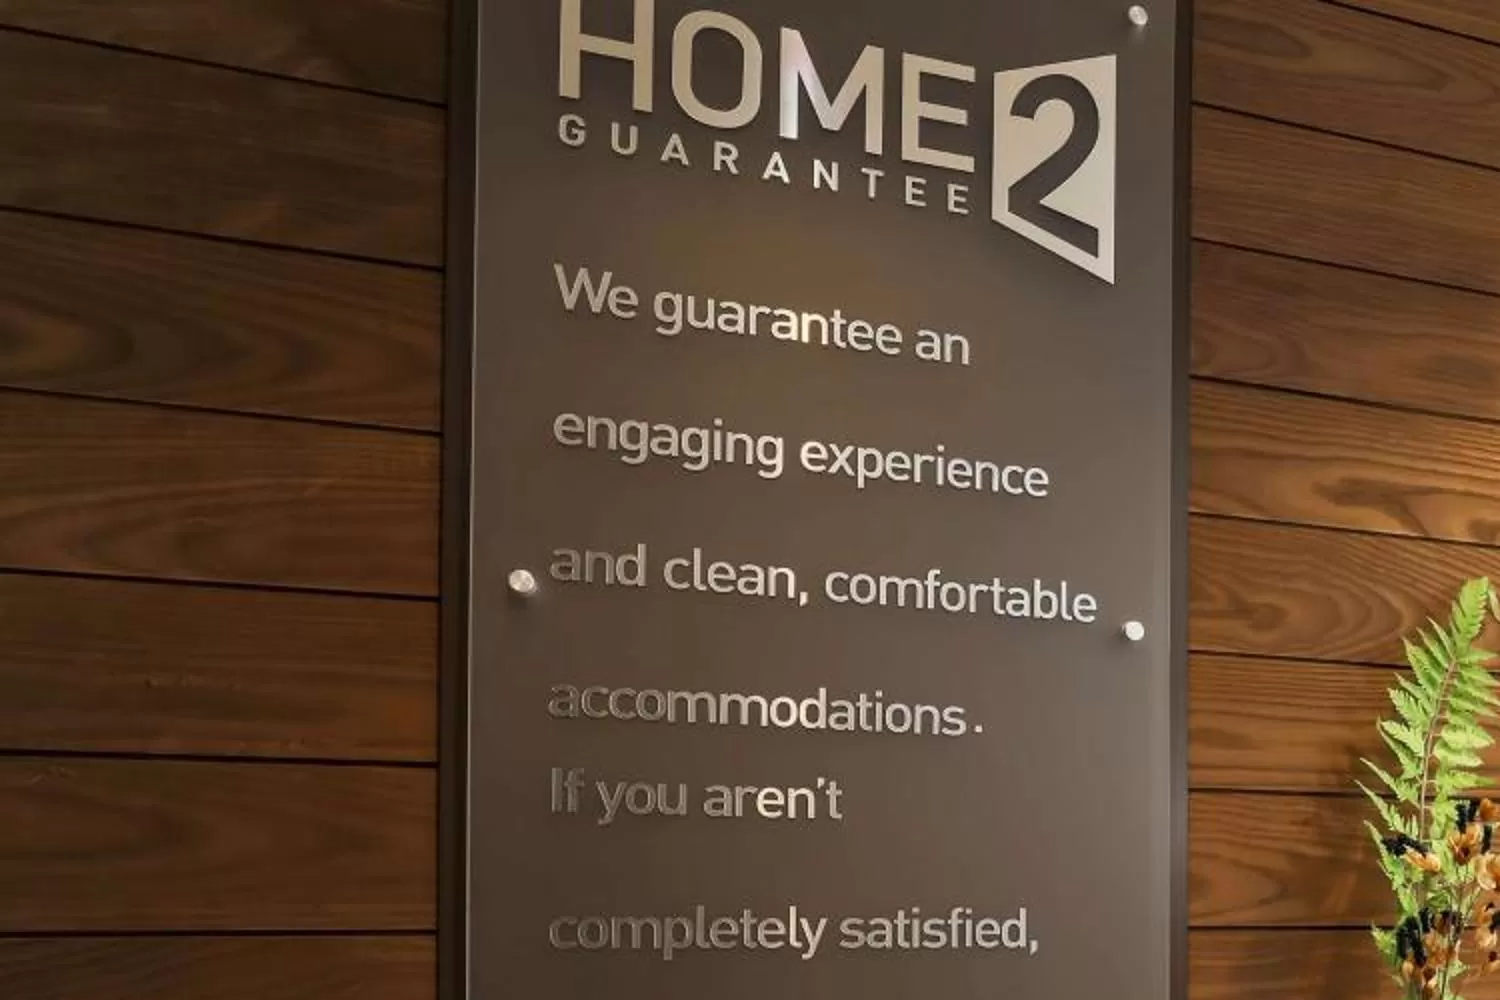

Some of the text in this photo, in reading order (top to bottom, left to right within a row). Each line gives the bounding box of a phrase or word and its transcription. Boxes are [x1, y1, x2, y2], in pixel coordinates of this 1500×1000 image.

[559, 114, 971, 215] GUARANTEE
[554, 263, 971, 365] We guarantee an
[554, 412, 1049, 497] engaging experience
[550, 544, 1098, 624] and clean, comfortable
[548, 682, 984, 736] accommodations.
[551, 766, 843, 824] If you aren't
[549, 905, 1038, 960] completely satisfied,
